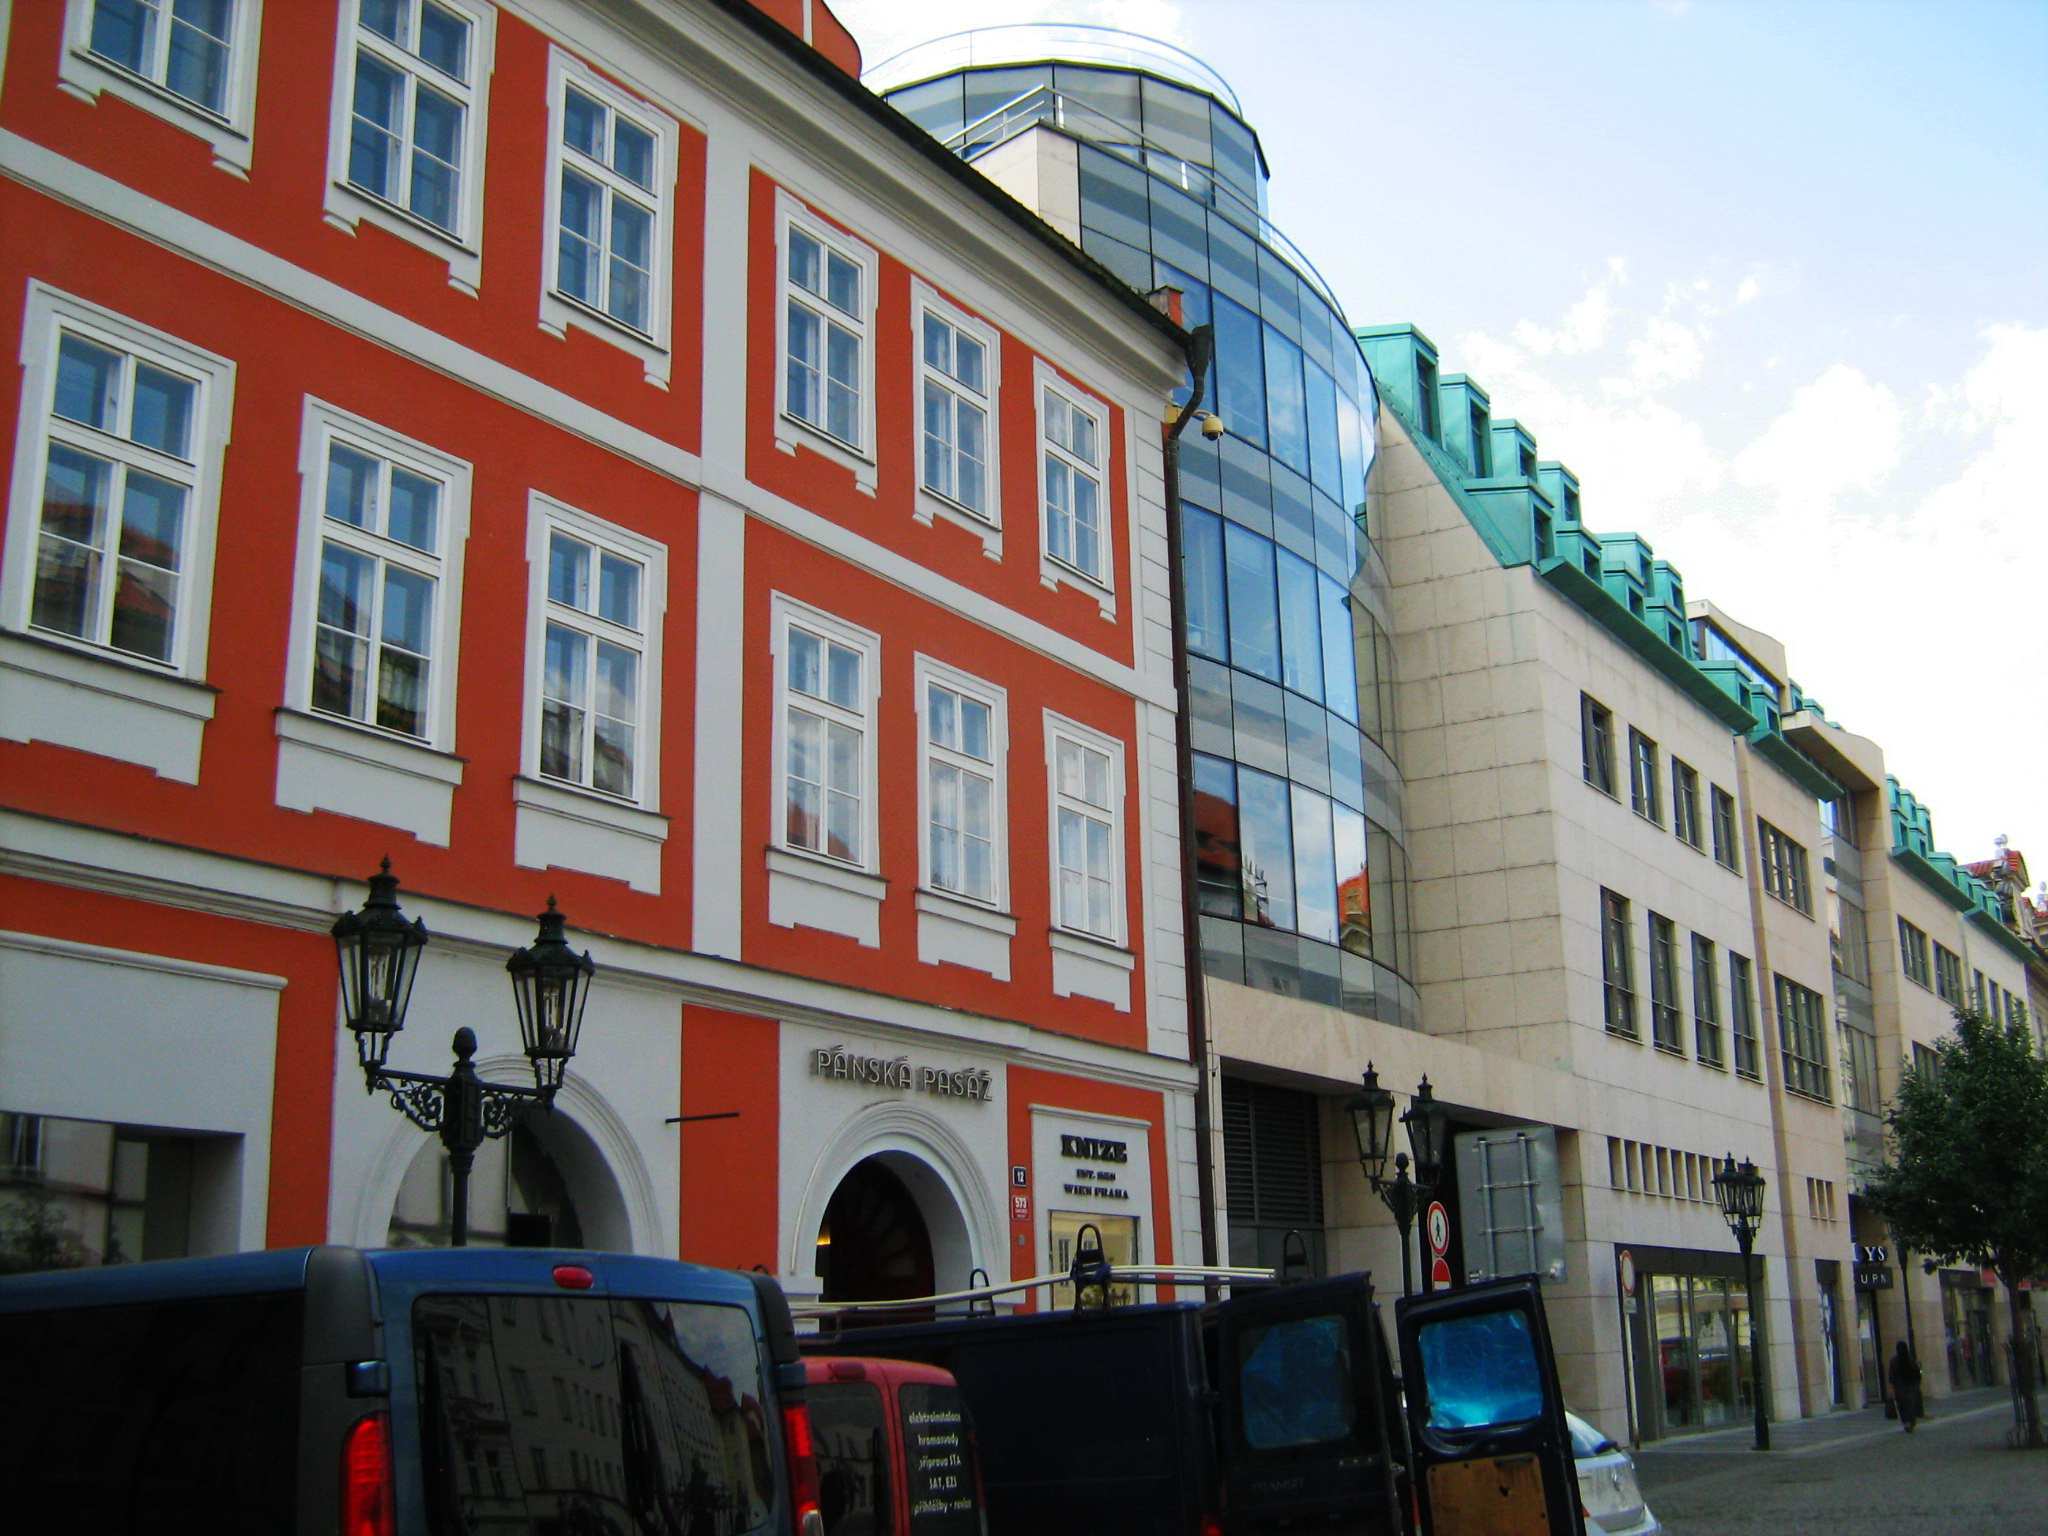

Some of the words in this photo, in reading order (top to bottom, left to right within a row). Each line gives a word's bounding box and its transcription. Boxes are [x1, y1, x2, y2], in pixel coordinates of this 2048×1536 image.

[812, 1045, 912, 1089] PÁNSKÁ
[917, 1067, 995, 1101] PASÁŽ
[1061, 1134, 1127, 1162] KNIZE
[1016, 1171, 1025, 1182] 12
[1063, 1184, 1092, 1195] WIEN
[1095, 1186, 1129, 1199] PRAHA
[1014, 1197, 1027, 1208] 573
[949, 1454, 962, 1466] STA
[929, 1477, 945, 1490] SAT,
